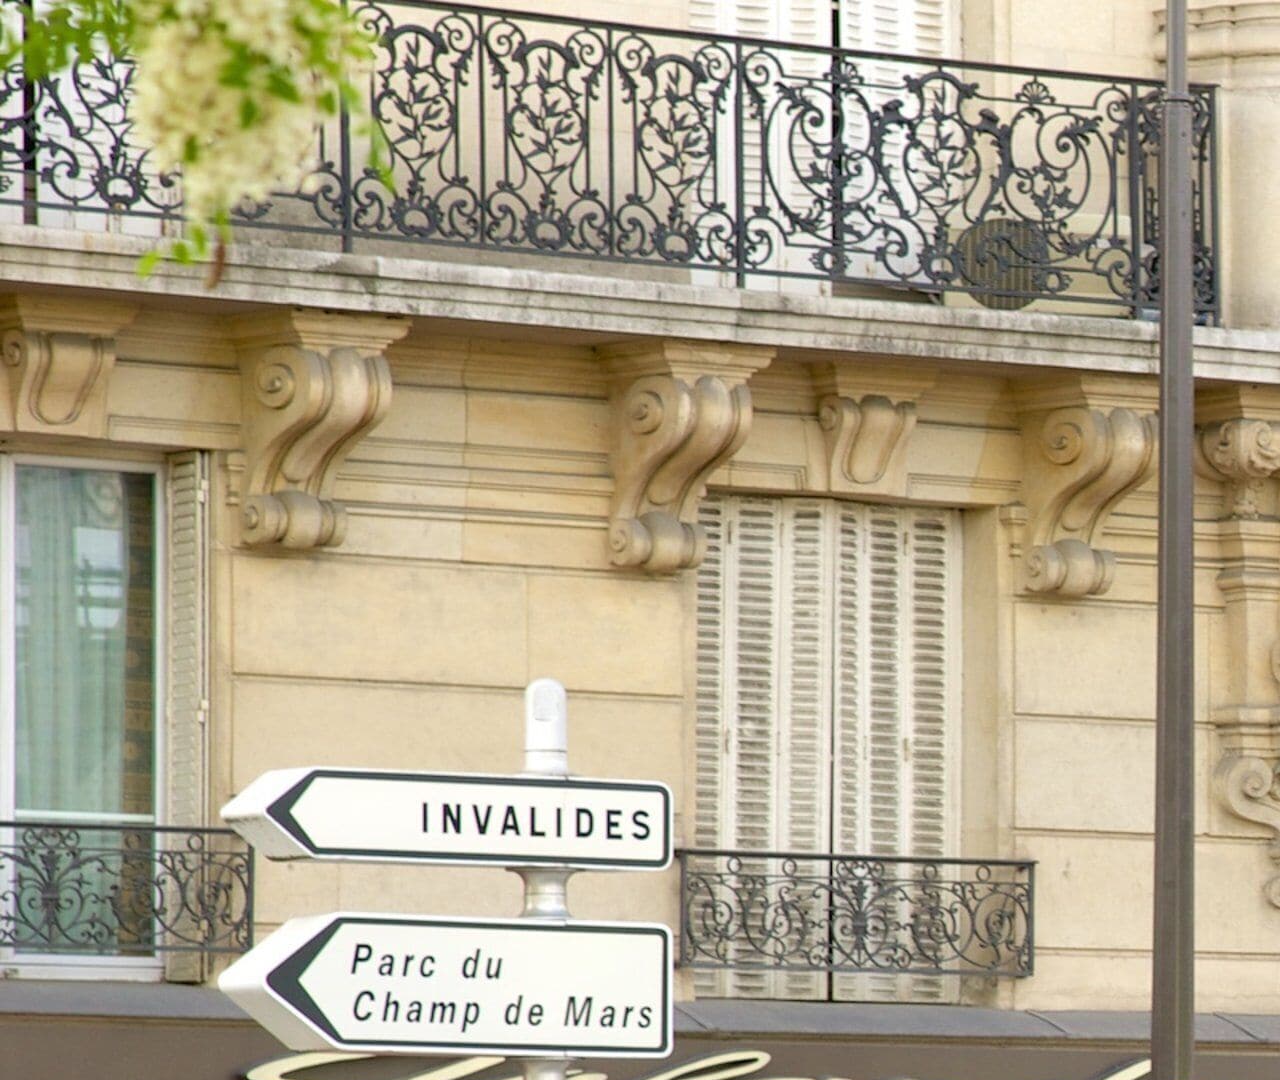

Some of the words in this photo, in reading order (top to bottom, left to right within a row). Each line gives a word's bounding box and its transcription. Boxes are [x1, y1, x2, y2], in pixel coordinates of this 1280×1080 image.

[421, 802, 652, 841] INVALIDES
[350, 944, 436, 976] Parc
[461, 948, 503, 980] du
[352, 991, 481, 1034] Champ
[504, 995, 544, 1027] de
[564, 996, 653, 1029] Mars
